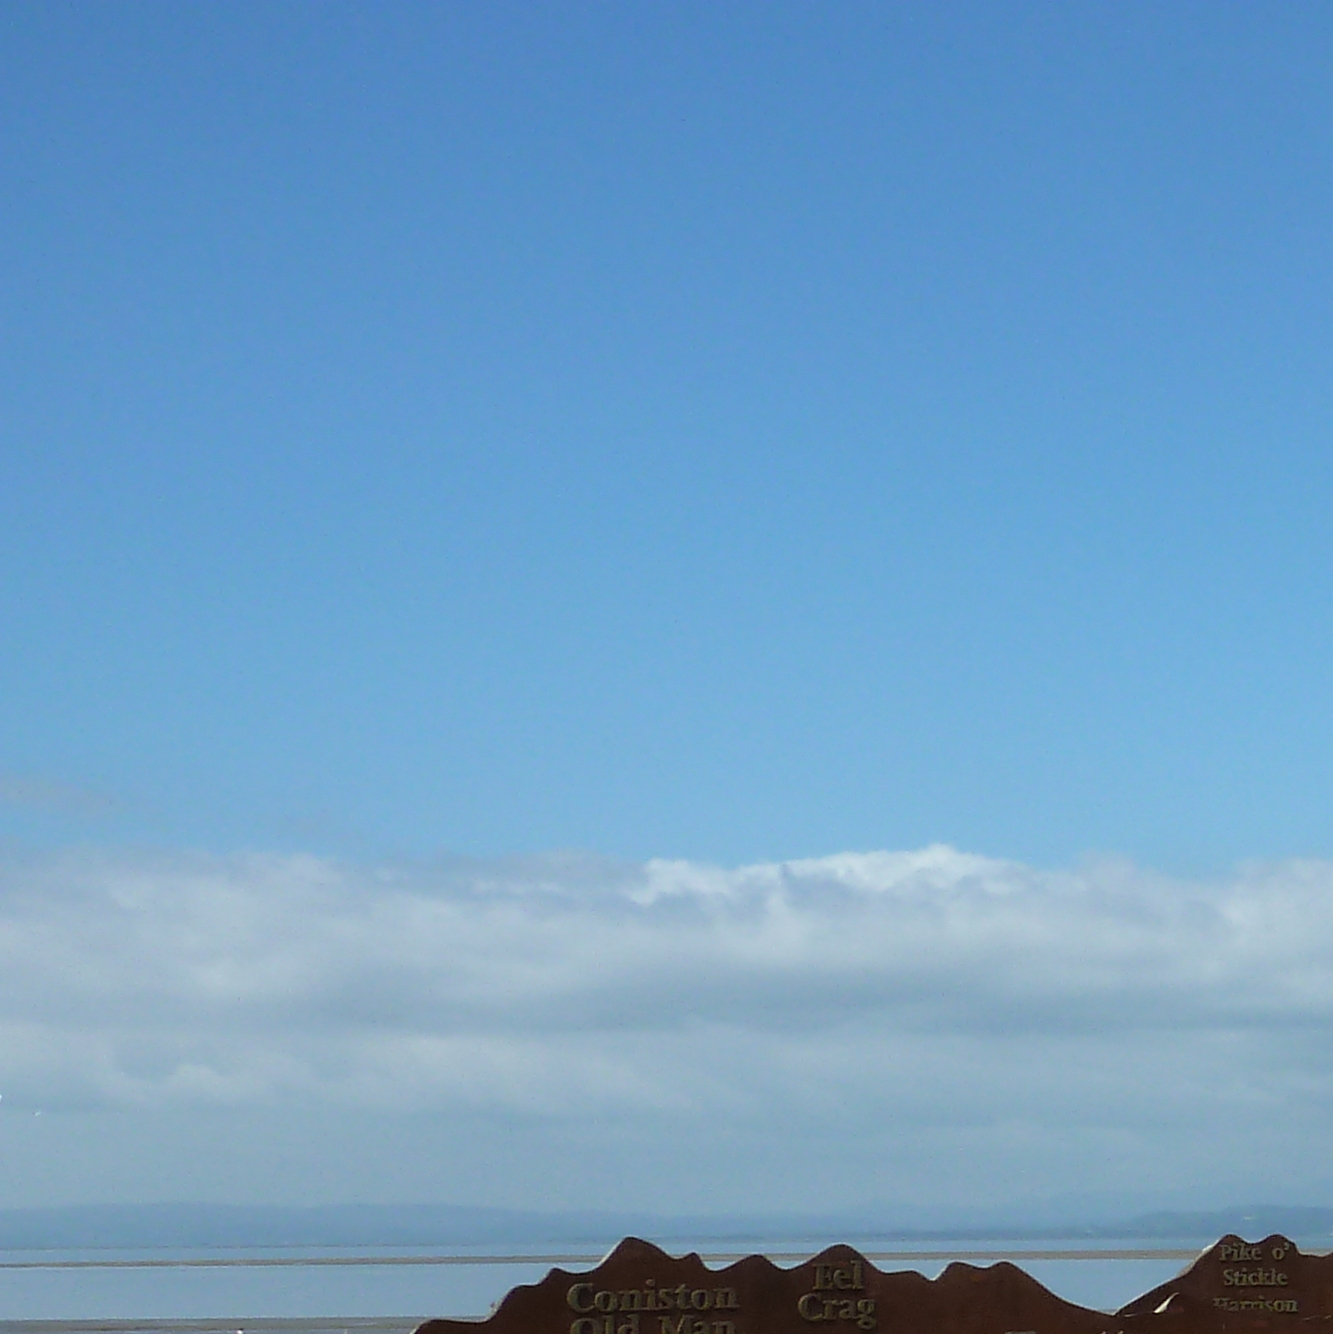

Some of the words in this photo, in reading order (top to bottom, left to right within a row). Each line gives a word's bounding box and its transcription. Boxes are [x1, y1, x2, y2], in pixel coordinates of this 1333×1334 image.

[1220, 1242, 1262, 1261] Pike
[812, 1260, 864, 1291] Eel
[1223, 1267, 1288, 1286] Stickle
[567, 1279, 740, 1313] Coniston
[798, 1292, 877, 1330] Crag
